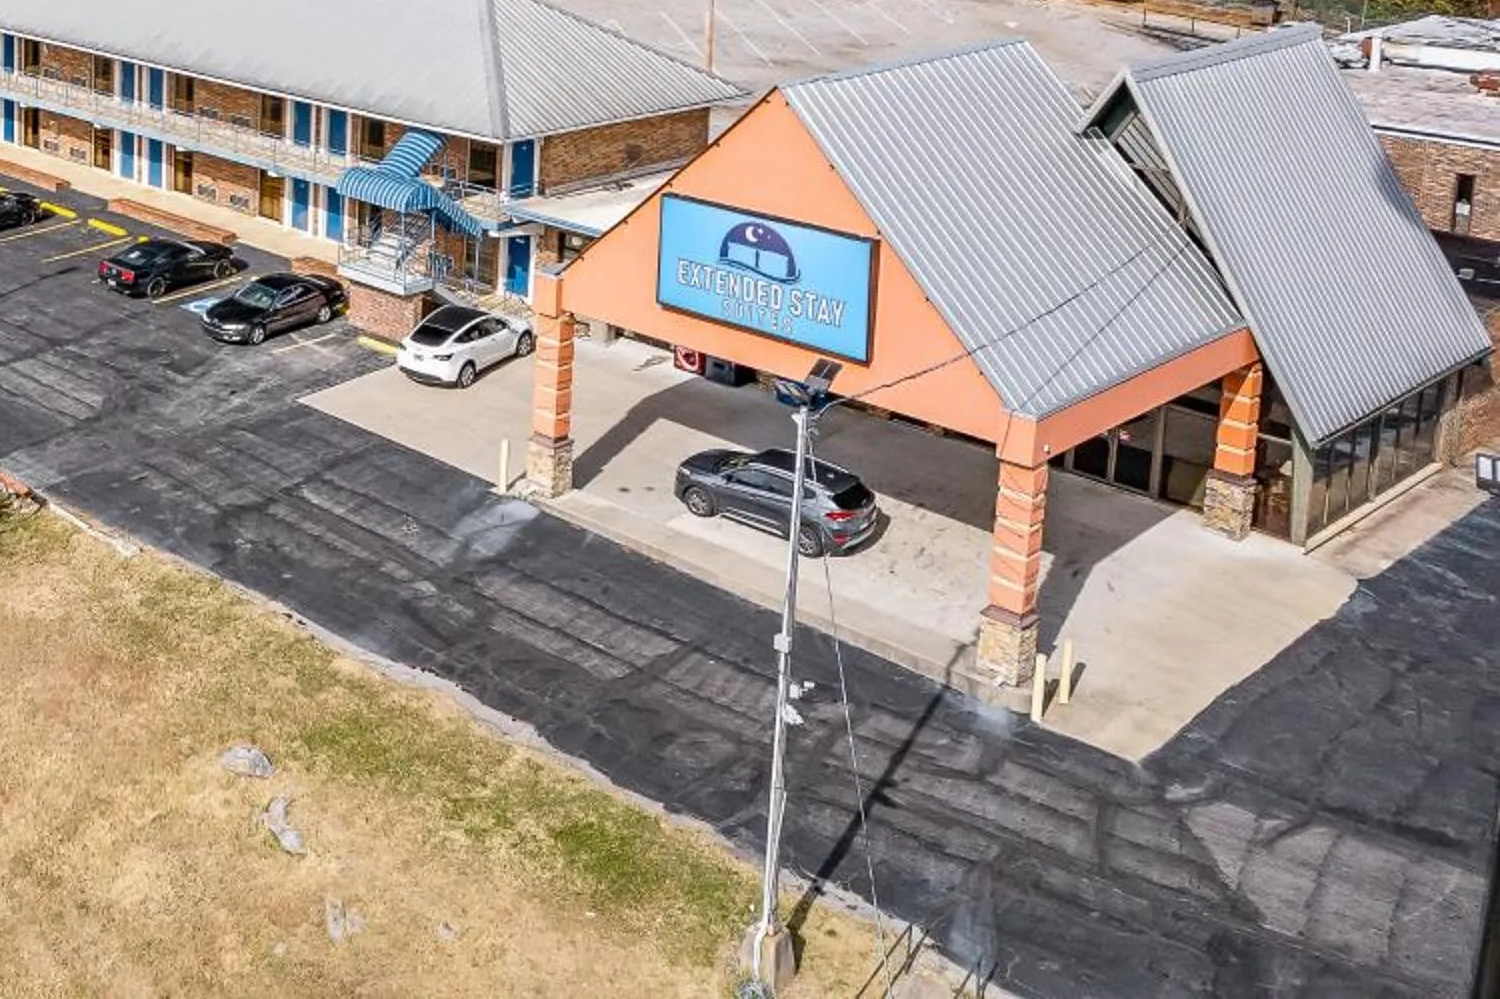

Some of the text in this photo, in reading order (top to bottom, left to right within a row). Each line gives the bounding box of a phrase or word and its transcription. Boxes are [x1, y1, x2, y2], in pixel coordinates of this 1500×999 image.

[678, 259, 844, 328] EXTENDED STAY
[723, 301, 792, 333] SUITES
